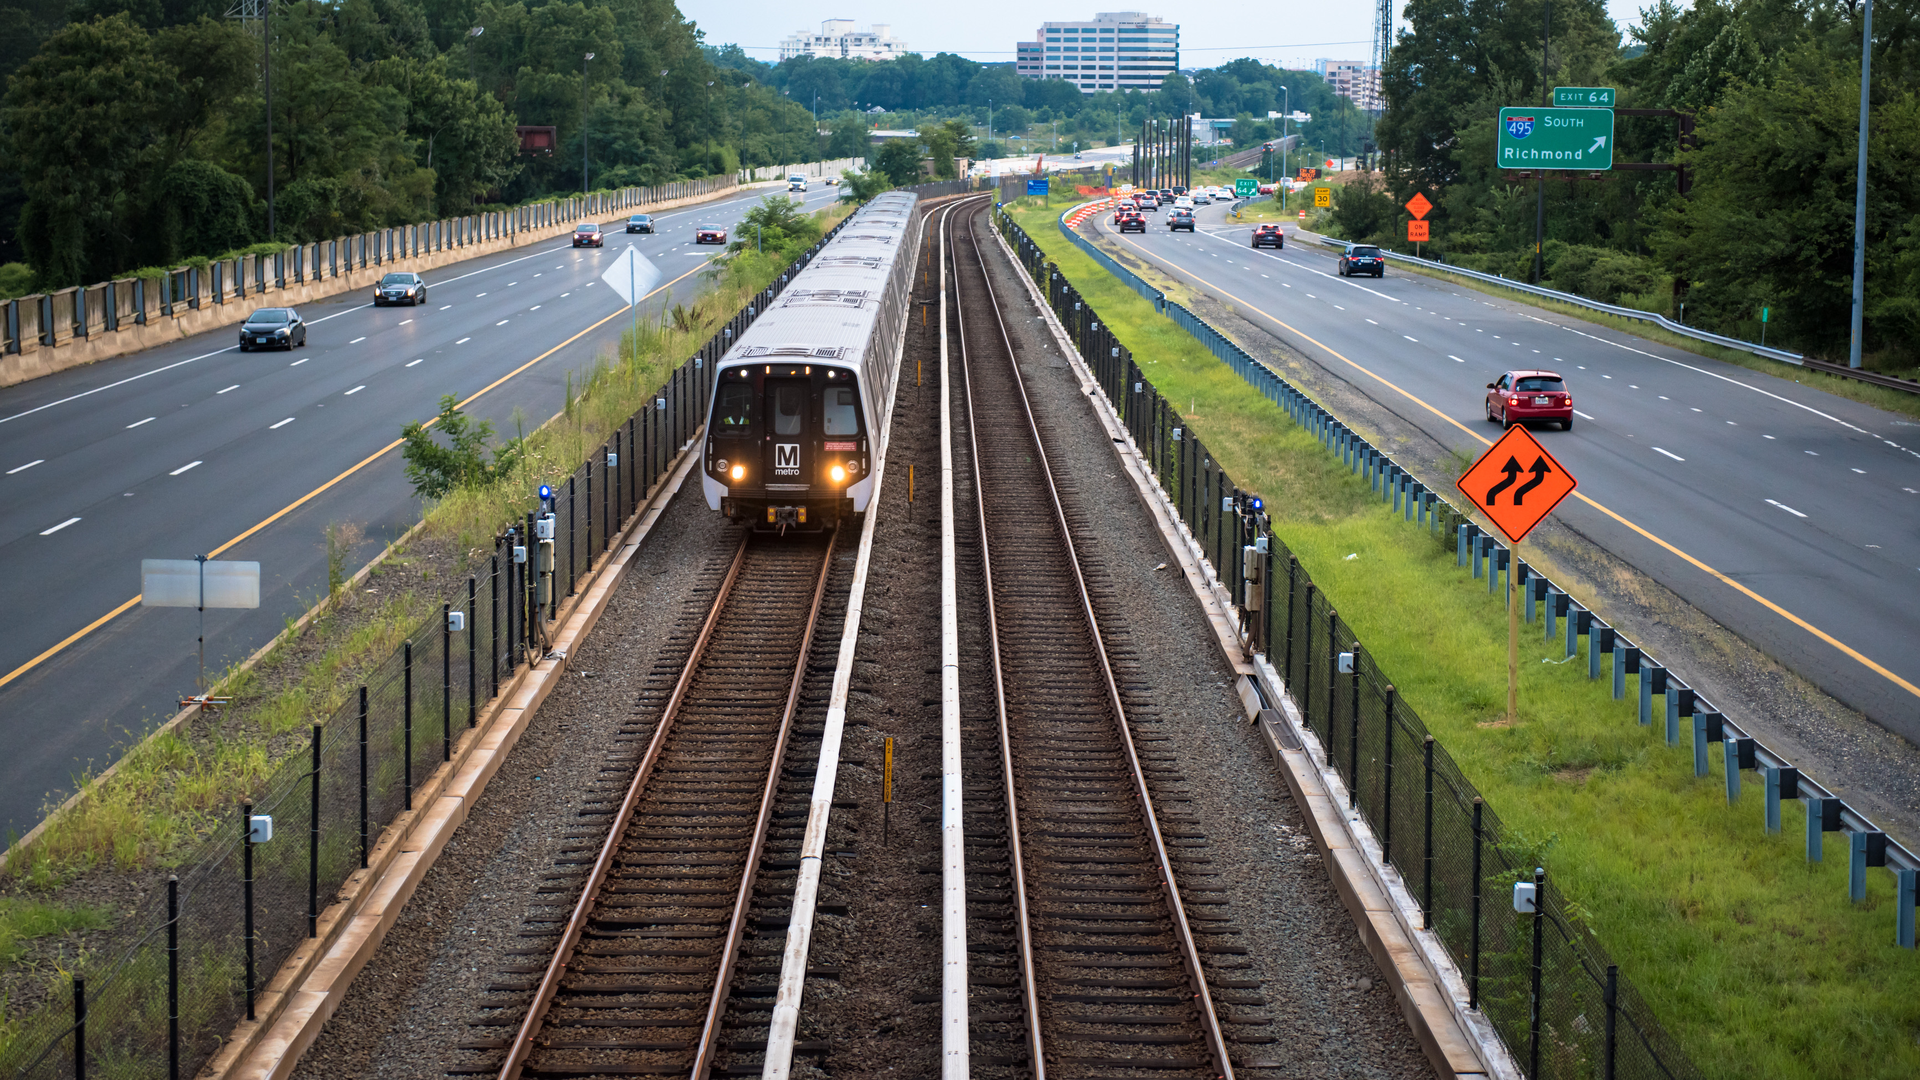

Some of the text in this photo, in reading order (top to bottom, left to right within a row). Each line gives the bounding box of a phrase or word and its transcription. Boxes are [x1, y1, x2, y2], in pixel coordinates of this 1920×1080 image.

[1560, 91, 1609, 103] EXIT 64
[1508, 116, 1584, 135] 495 SOUTH
[1504, 148, 1582, 160] Richmond
[777, 445, 798, 467] M
[775, 468, 800, 476] metro
